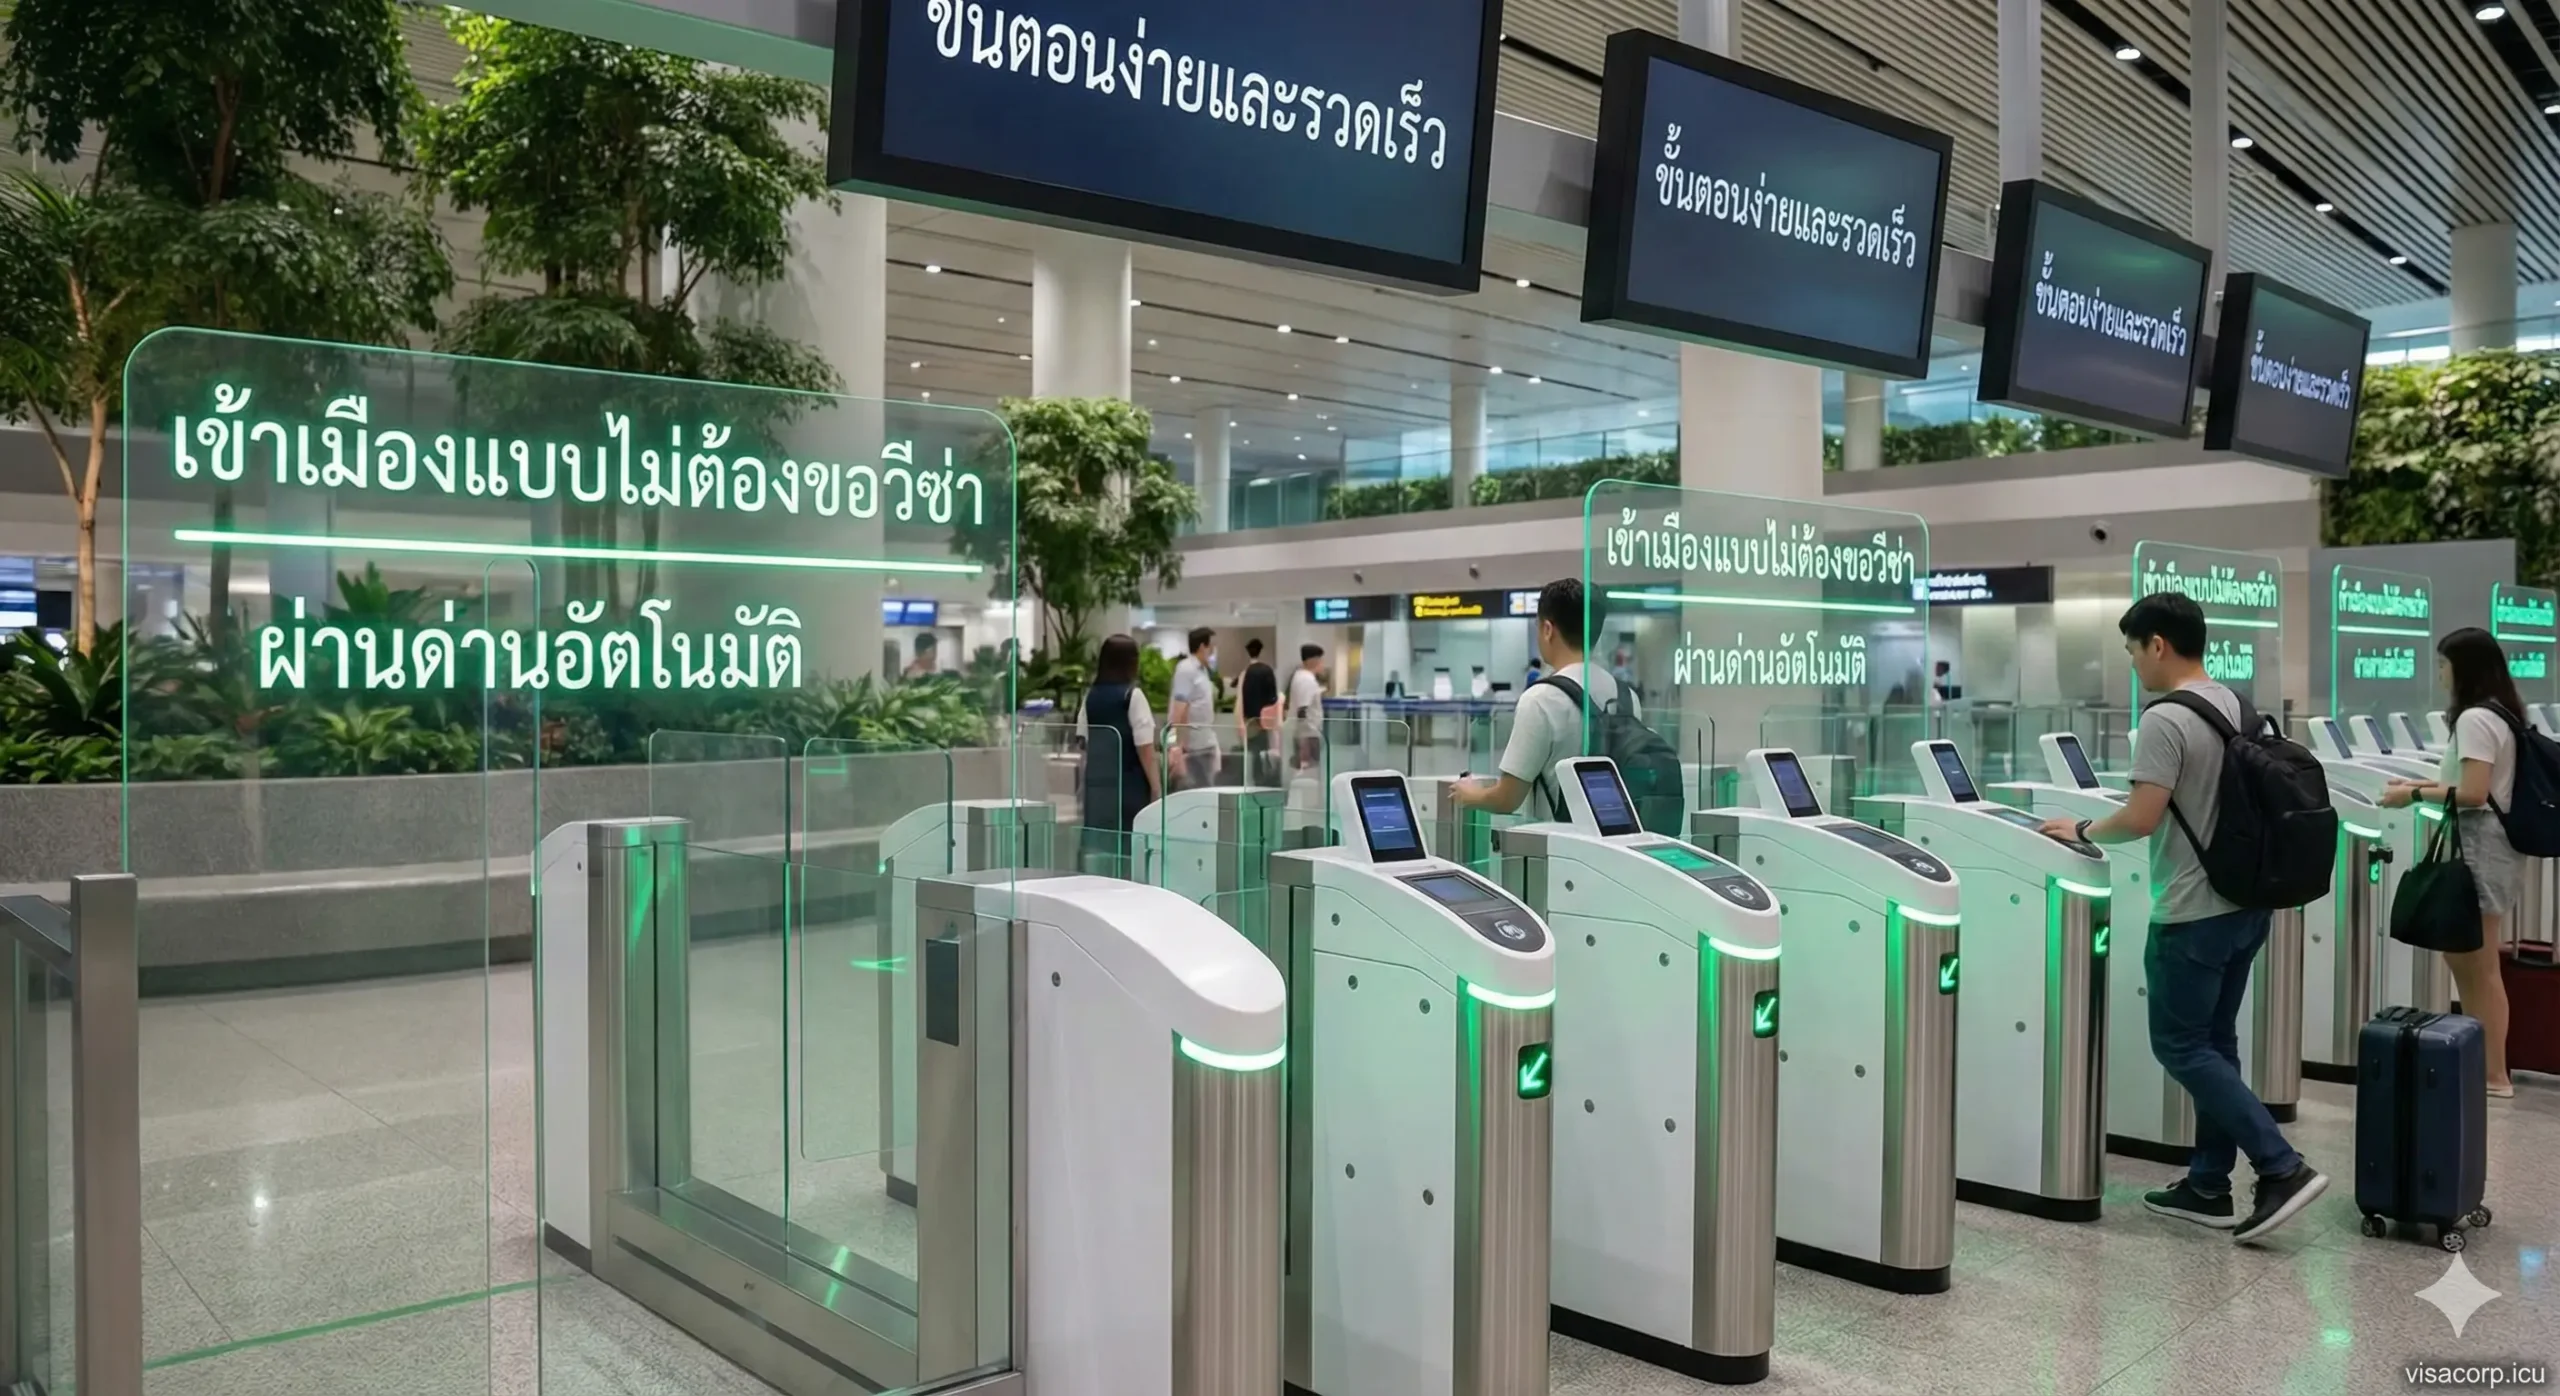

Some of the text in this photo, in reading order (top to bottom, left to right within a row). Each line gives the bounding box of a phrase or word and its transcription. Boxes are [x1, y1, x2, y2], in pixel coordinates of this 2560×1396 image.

[928, 0, 1446, 170] ขนตอนง่ายและรวดเร็ว
[1655, 122, 1917, 268] ขั้นตอนง่ายและรวดเร็ว
[172, 383, 985, 525] เข้าเมืองแบบไม่ต้องขอวีซ่า
[1606, 507, 1916, 585] เข้าเมืองแบบไม่ต้องขอวีซ่า
[258, 597, 804, 689] ผ่านด่านอัตโนมัติ
[1673, 631, 1866, 686] ผ่านด่านอัตโนมัติ
